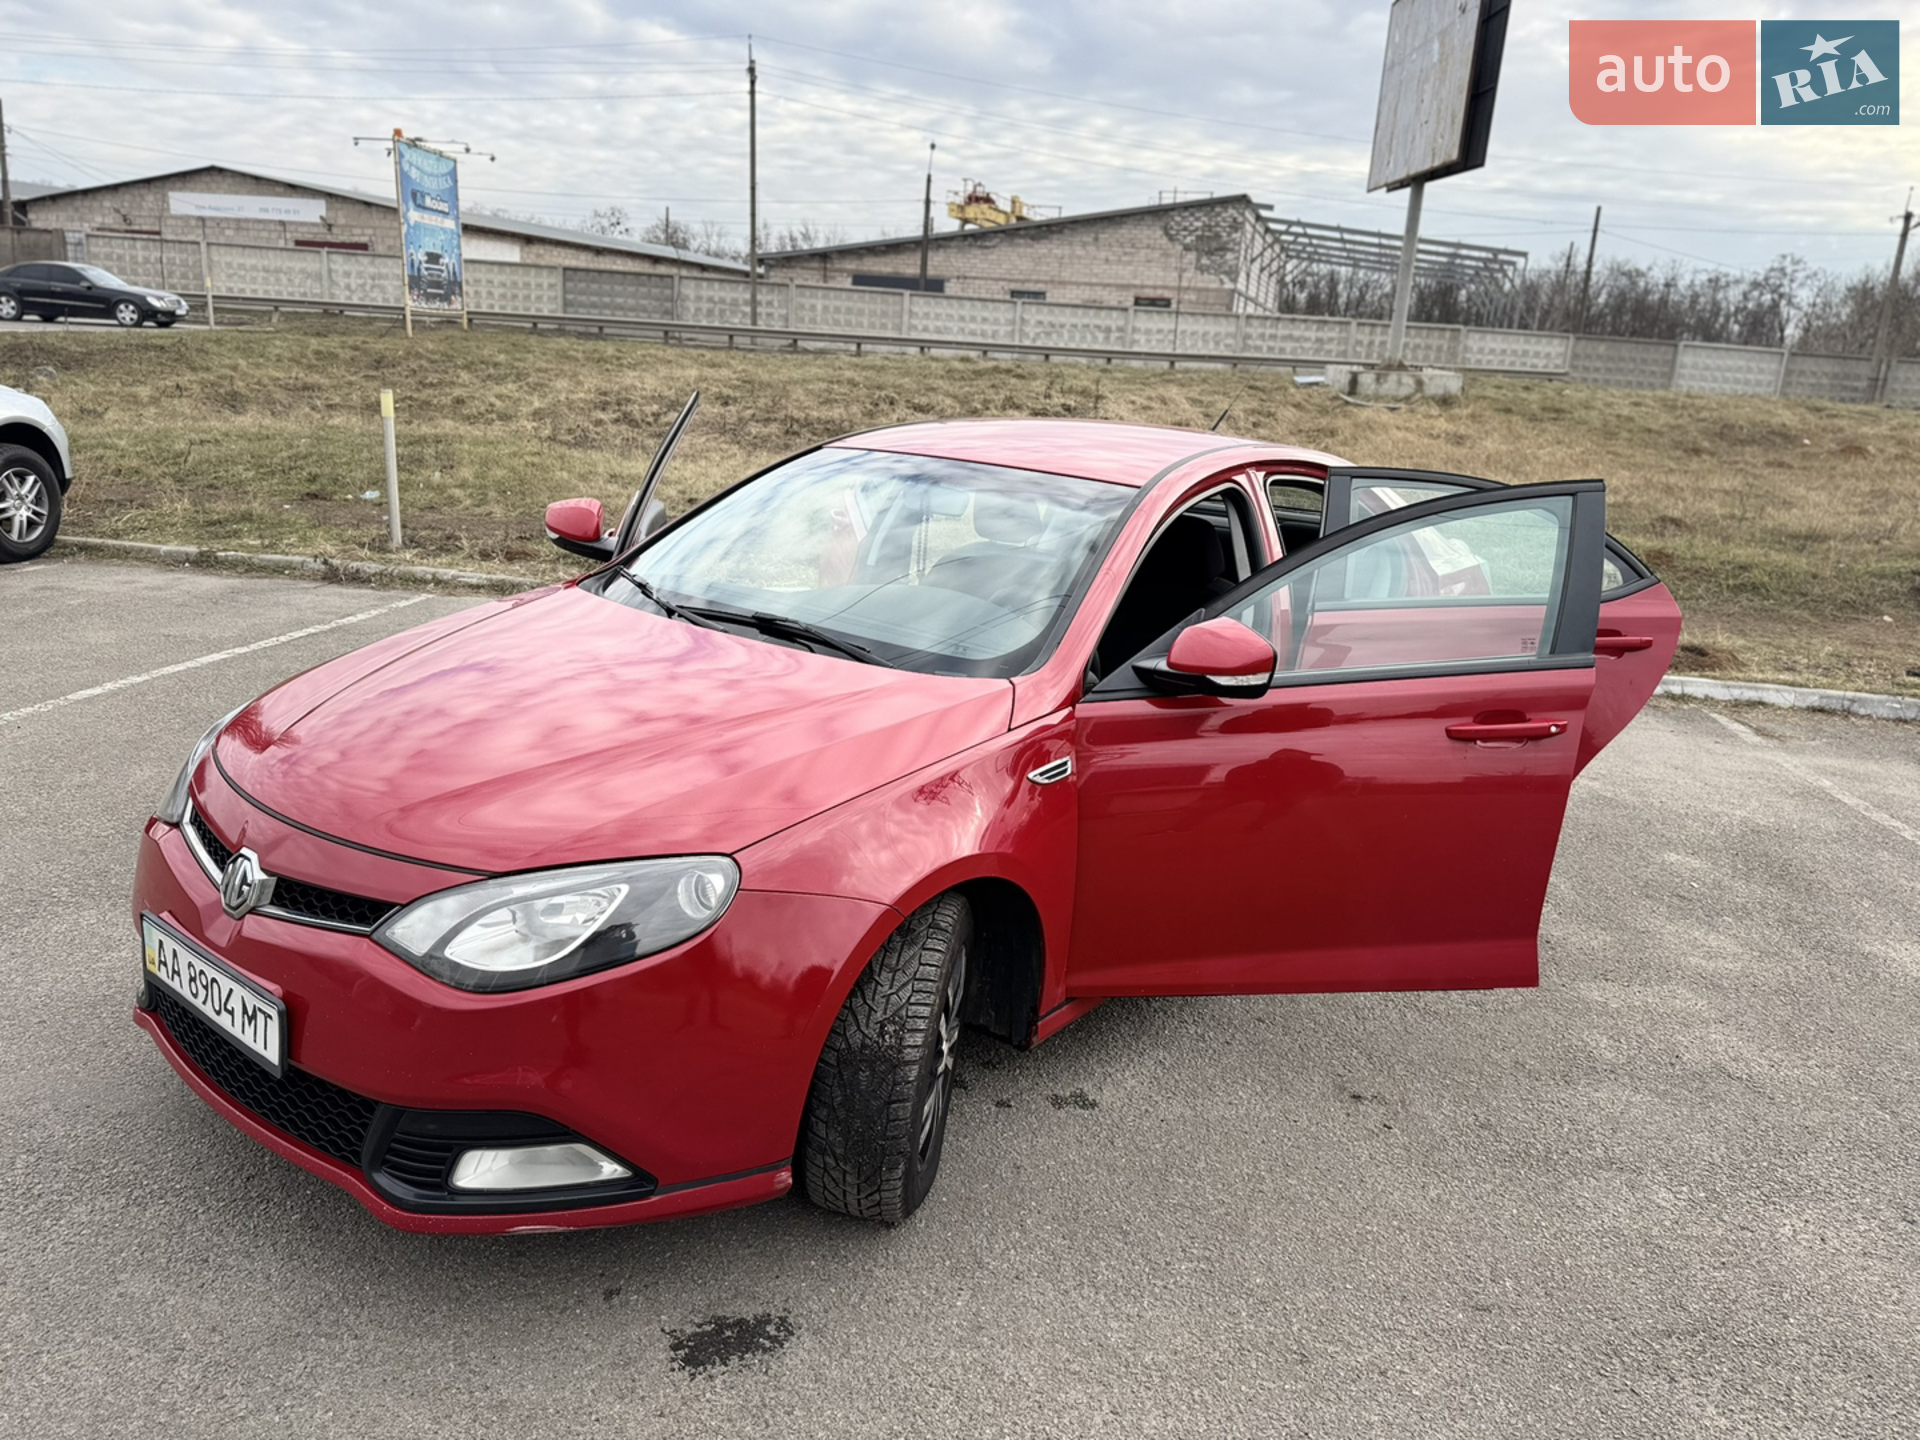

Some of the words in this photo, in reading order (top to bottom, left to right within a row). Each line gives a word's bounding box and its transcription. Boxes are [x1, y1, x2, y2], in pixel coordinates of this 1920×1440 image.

[158, 938, 184, 990] AA
[187, 960, 236, 1029] 8904
[240, 995, 274, 1051] MT
